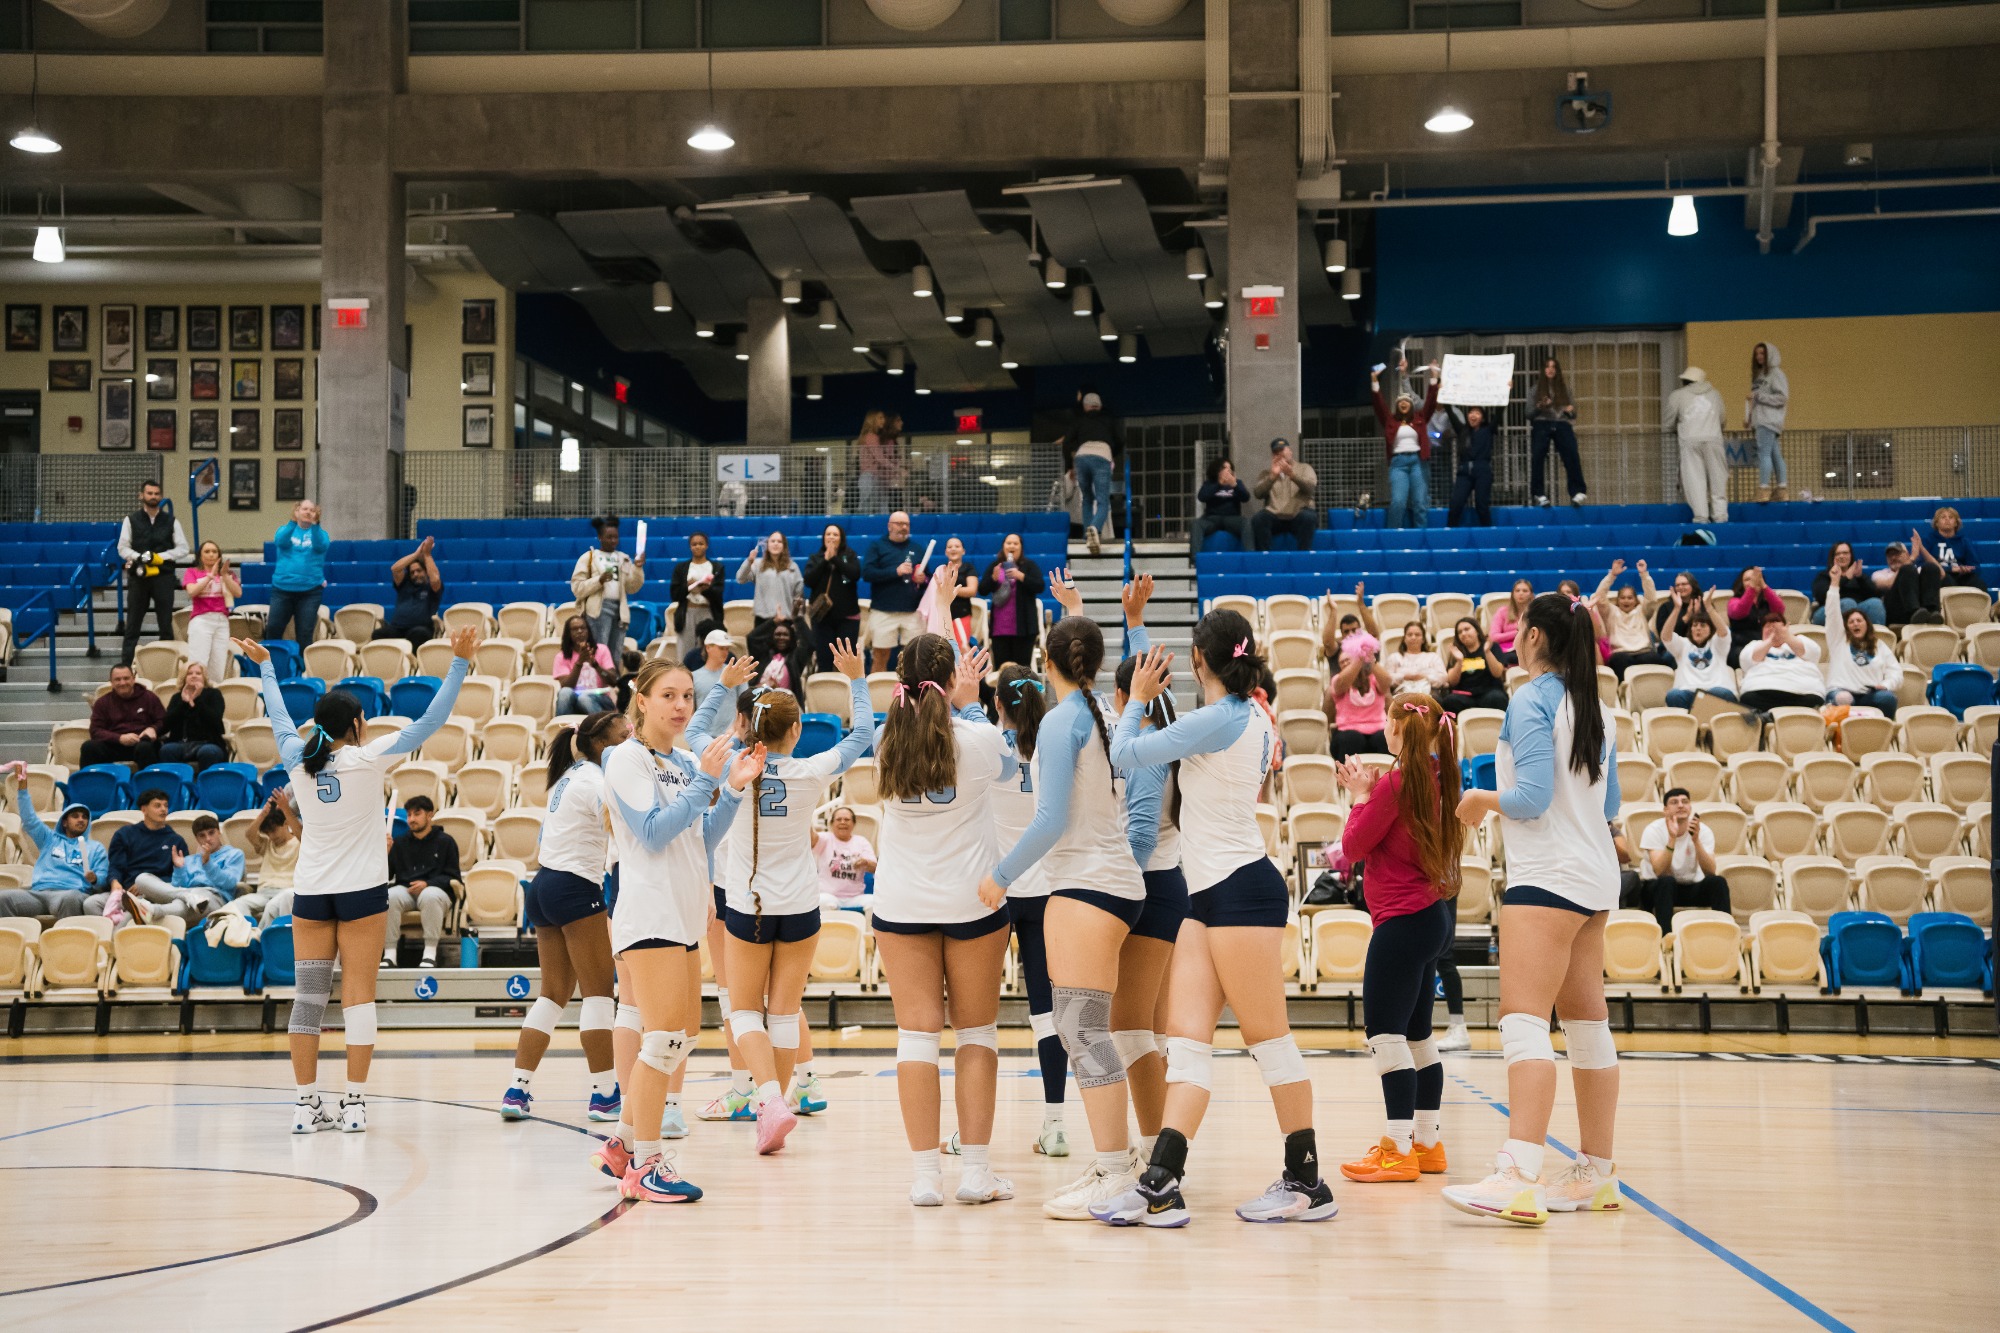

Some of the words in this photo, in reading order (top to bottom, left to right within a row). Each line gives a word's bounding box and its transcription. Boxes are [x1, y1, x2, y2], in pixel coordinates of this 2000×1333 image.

[1725, 442, 1748, 465] M
[316, 772, 342, 804] 5
[758, 777, 788, 817] 2
